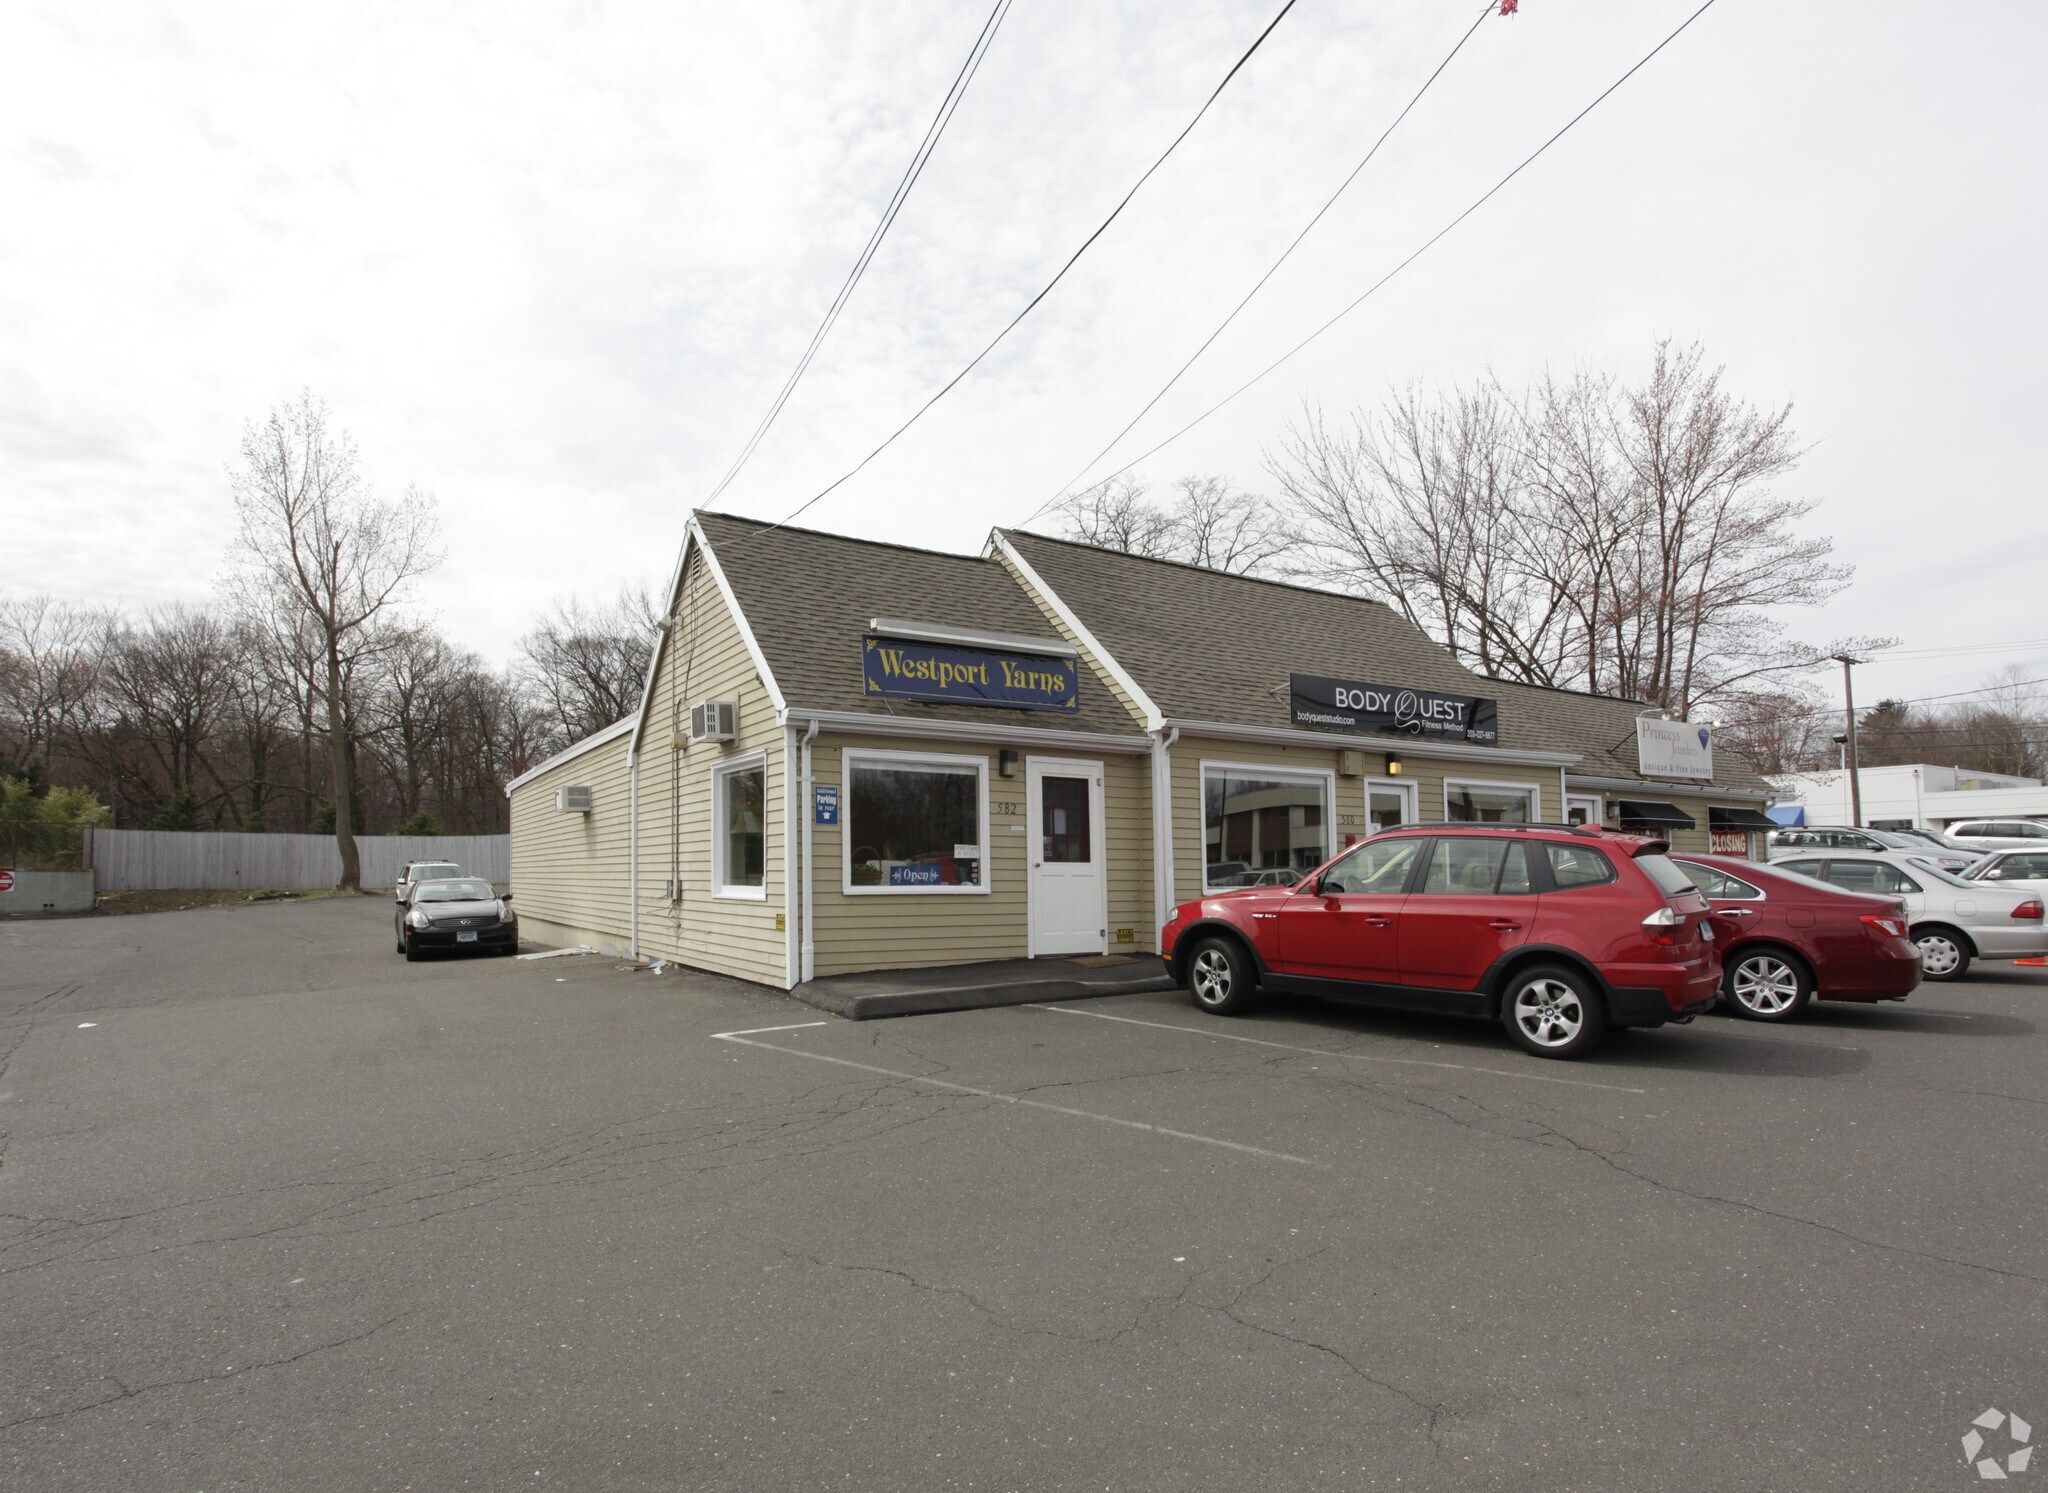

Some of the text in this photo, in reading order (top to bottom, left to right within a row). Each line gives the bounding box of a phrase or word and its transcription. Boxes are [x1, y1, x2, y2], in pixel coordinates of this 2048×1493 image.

[877, 648, 1065, 696] Westport Yarns
[1335, 687, 1391, 712] BODY
[1297, 710, 1356, 725] bodyqueststudio.com
[1421, 720, 1464, 732] Fitness Method
[1642, 720, 1680, 741] Princess
[1670, 742, 1698, 759] Jewelers
[1644, 762, 1668, 772] Antique
[1675, 764, 1689, 773] Fine
[816, 794, 837, 806] Parking
[997, 803, 1017, 815] 582
[1712, 834, 1746, 853] CLOSING
[903, 868, 929, 883] Open
